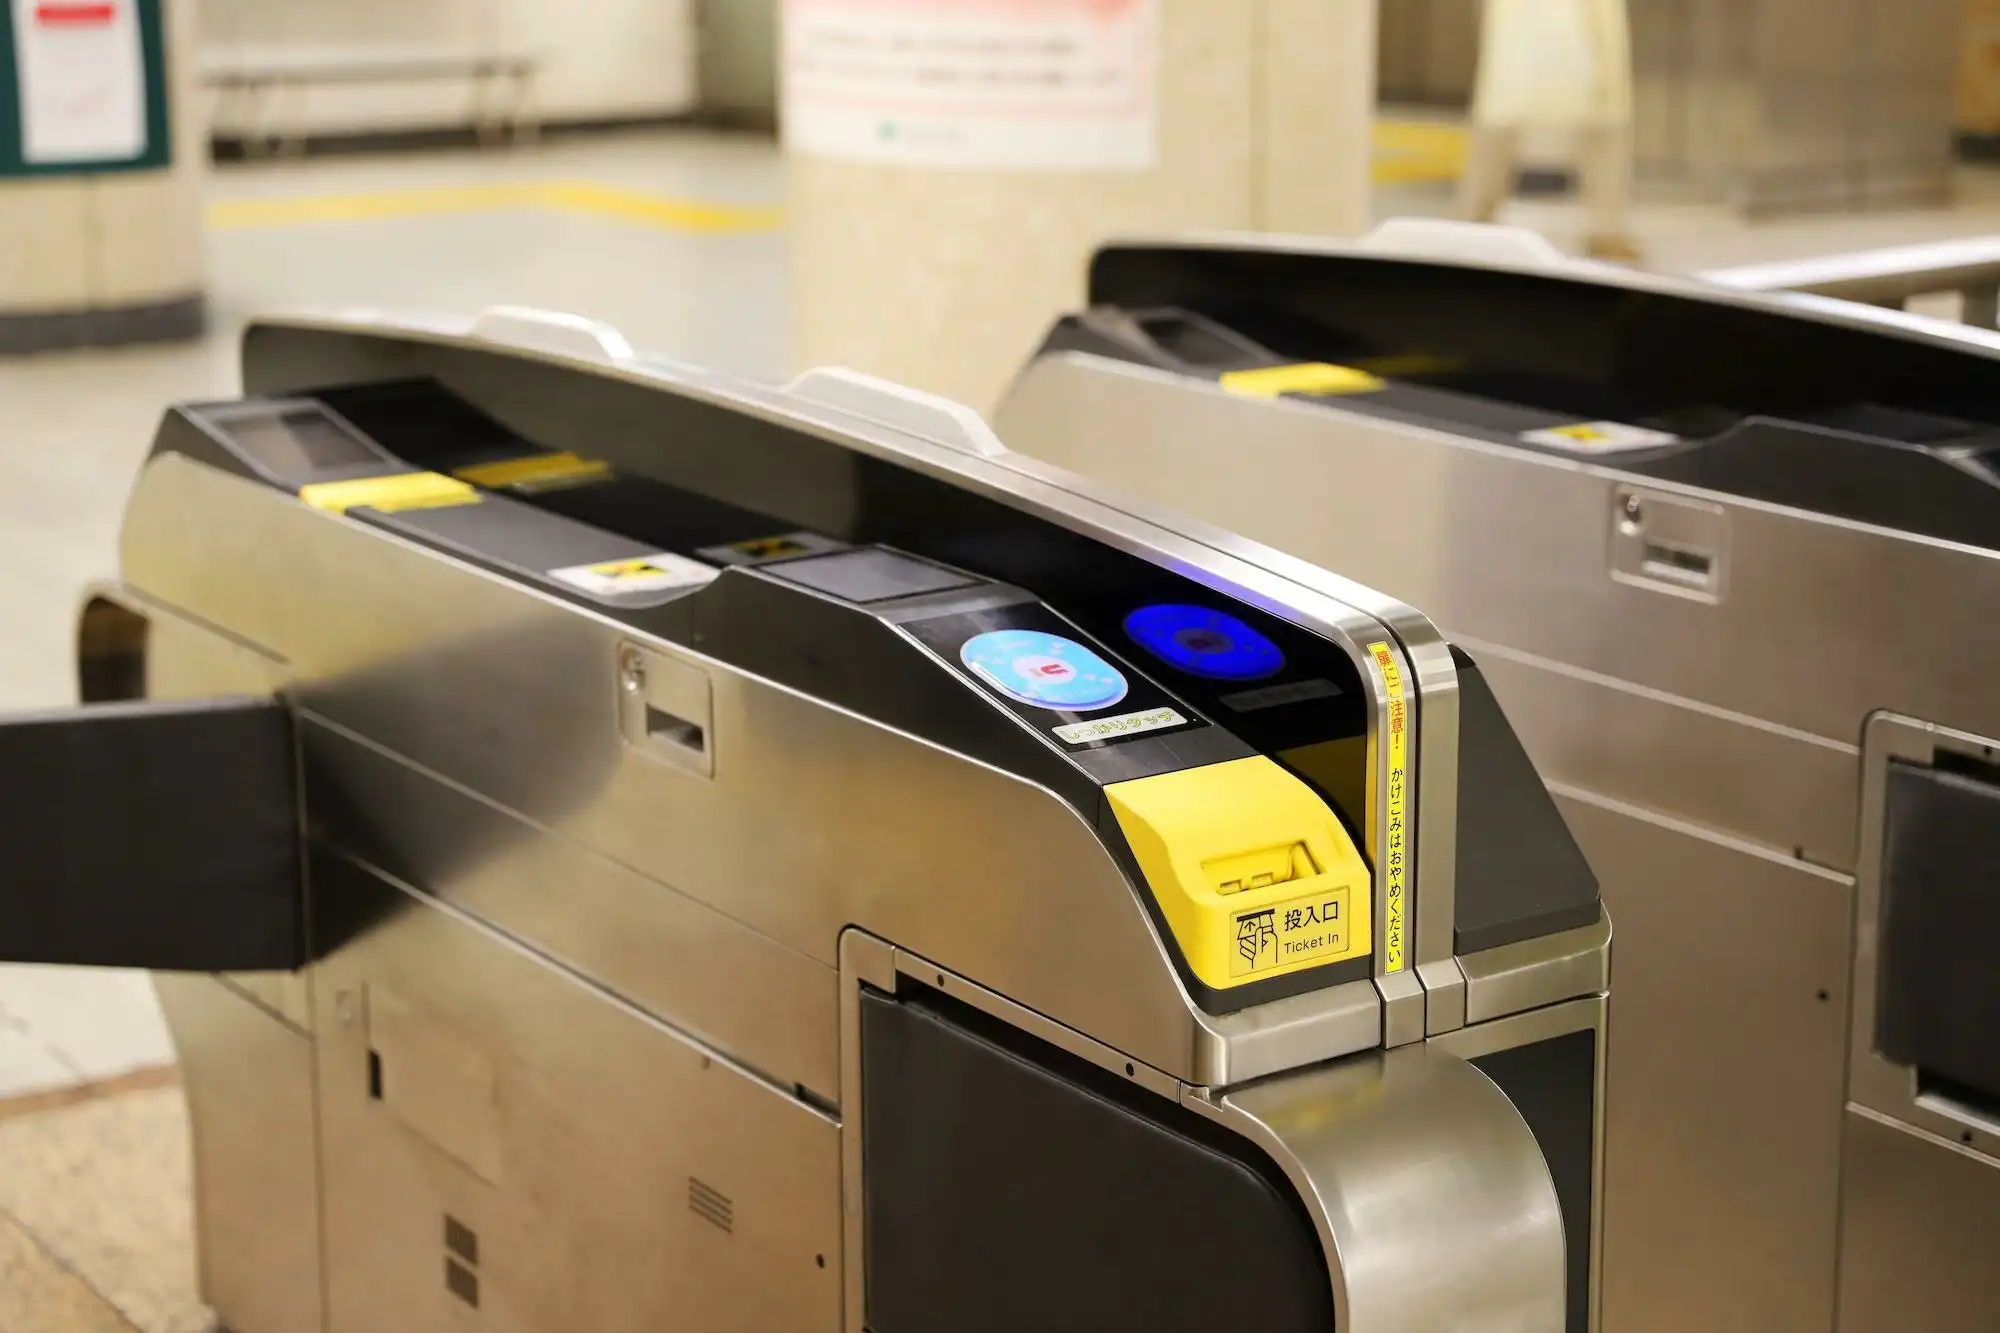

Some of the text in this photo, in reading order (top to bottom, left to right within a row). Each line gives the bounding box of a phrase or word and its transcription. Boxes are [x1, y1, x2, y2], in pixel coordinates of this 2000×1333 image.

[1388, 767, 1403, 964] かけこみはおやめください
[1284, 901, 1339, 932] 投入口
[1284, 933, 1339, 955] Ticket In
